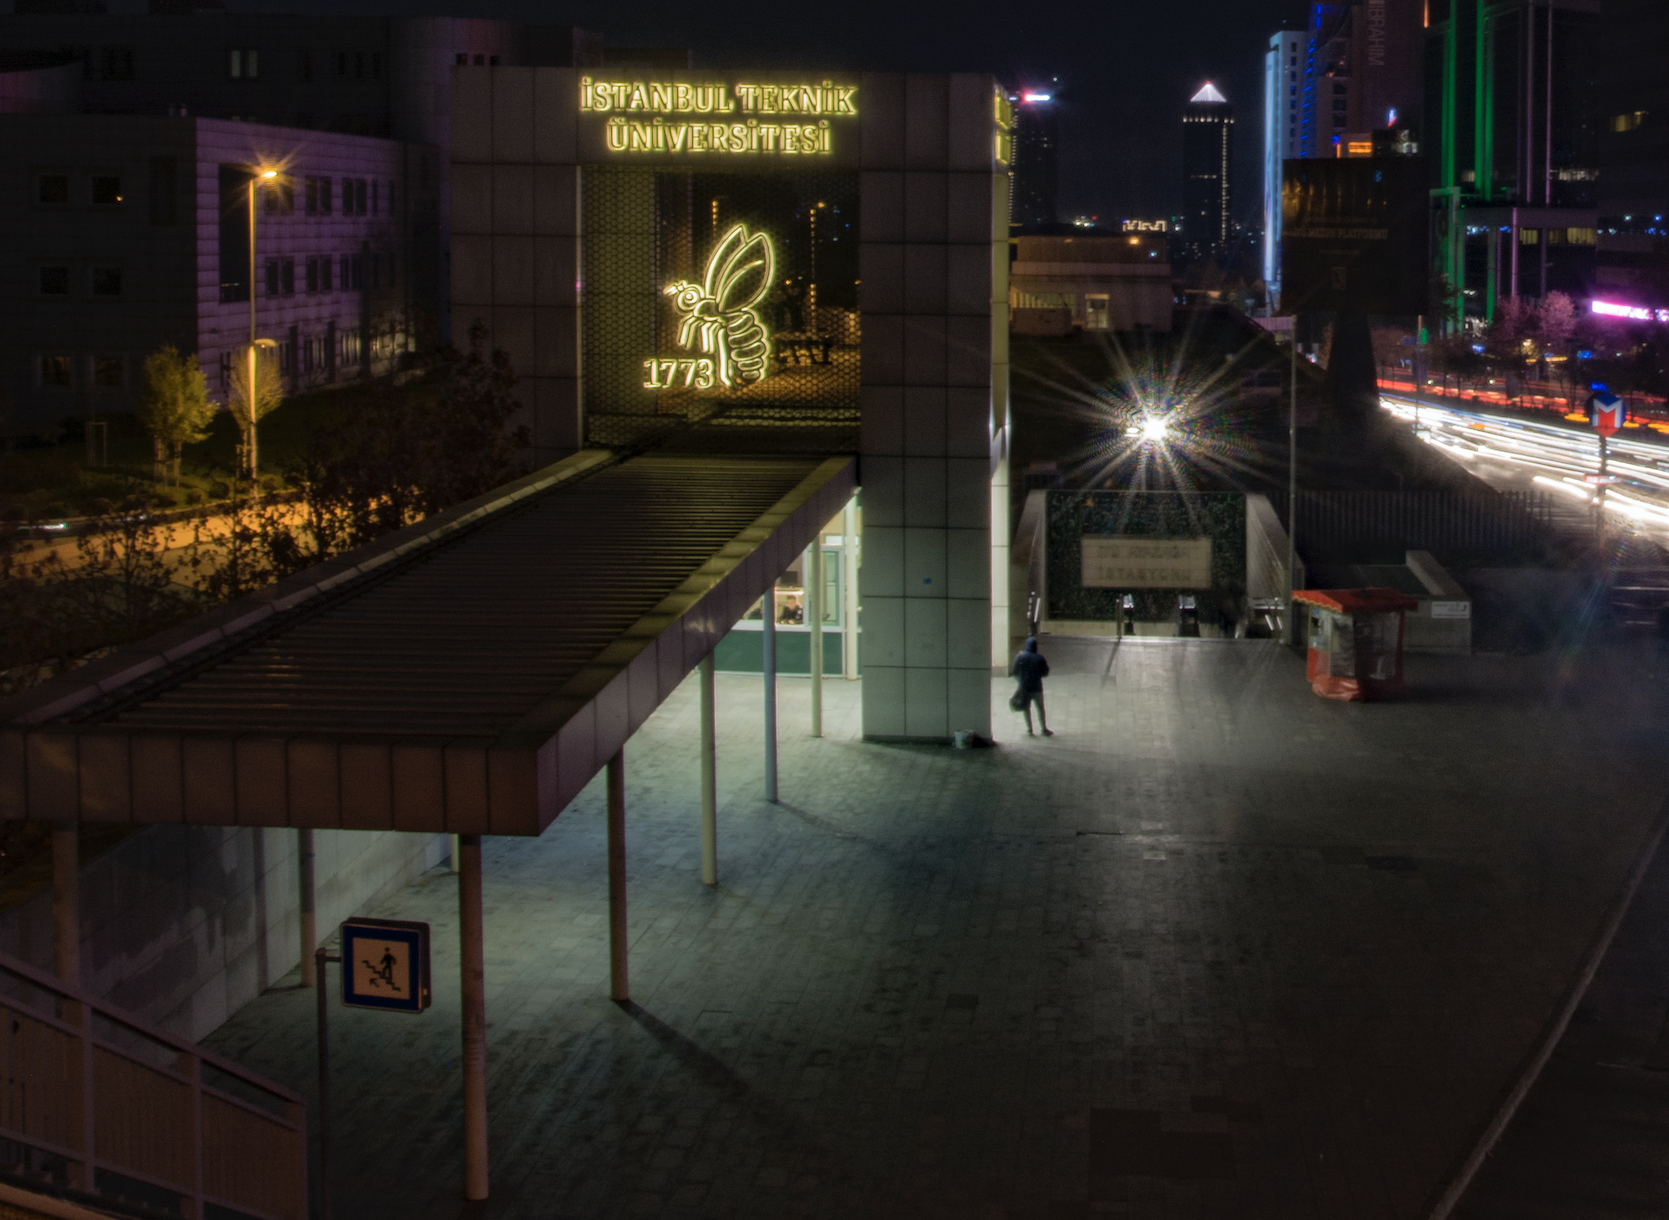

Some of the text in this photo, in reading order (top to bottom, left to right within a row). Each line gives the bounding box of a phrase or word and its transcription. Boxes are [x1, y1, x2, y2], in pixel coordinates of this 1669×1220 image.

[580, 76, 860, 116] İSTANBUL TEKNİK
[606, 117, 832, 154] ÜNİVERSİTESİ
[643, 358, 715, 389] 1773
